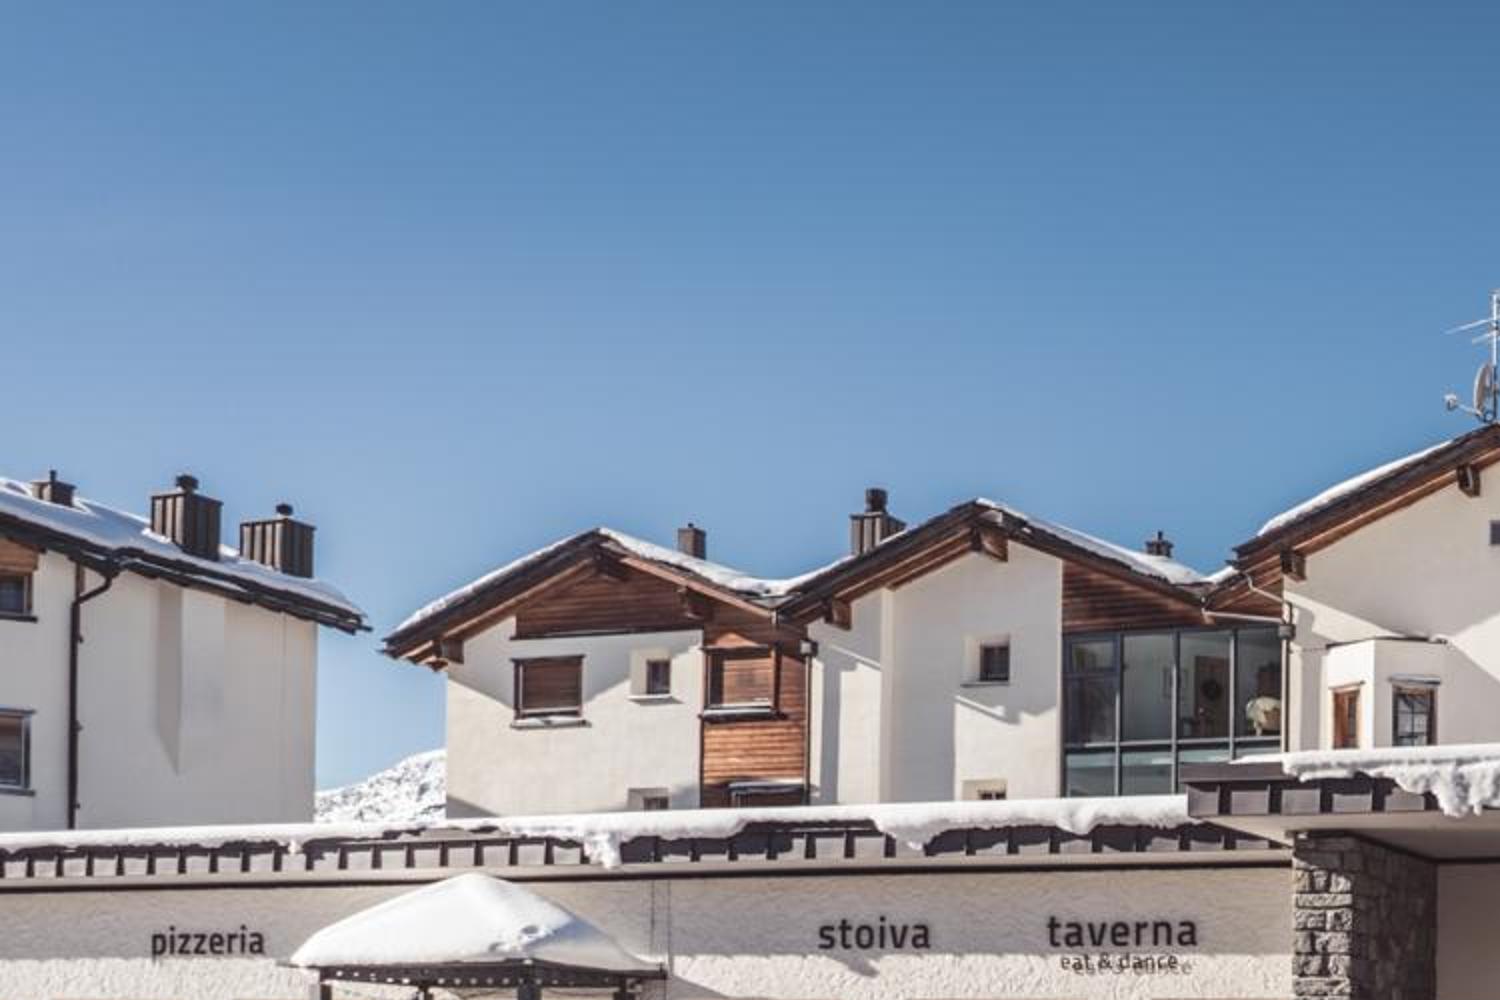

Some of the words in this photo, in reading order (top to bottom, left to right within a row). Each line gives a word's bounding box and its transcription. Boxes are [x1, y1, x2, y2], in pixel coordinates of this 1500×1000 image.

[151, 924, 265, 963] pizzeria
[818, 916, 931, 950] stoiva
[1046, 916, 1198, 948] taverna
[1060, 953, 1093, 971] eat
[1098, 952, 1112, 970] &
[1119, 952, 1178, 971] dance
